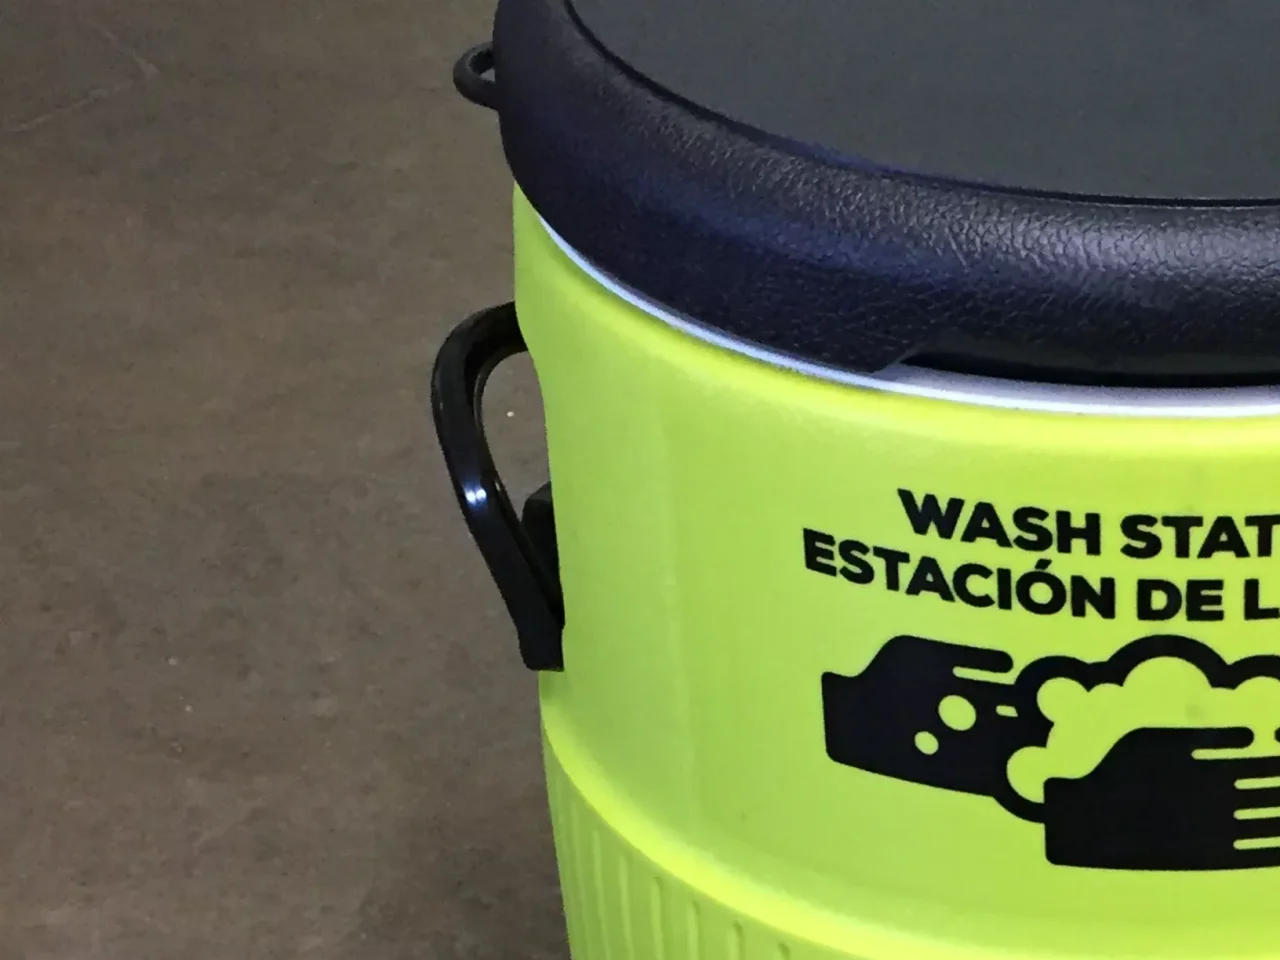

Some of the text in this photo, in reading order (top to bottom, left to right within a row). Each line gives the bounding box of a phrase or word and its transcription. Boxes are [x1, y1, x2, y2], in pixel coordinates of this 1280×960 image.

[897, 488, 1102, 556] WASH
[802, 527, 1116, 619] ESTACIÓN
[1136, 578, 1225, 622] DE
